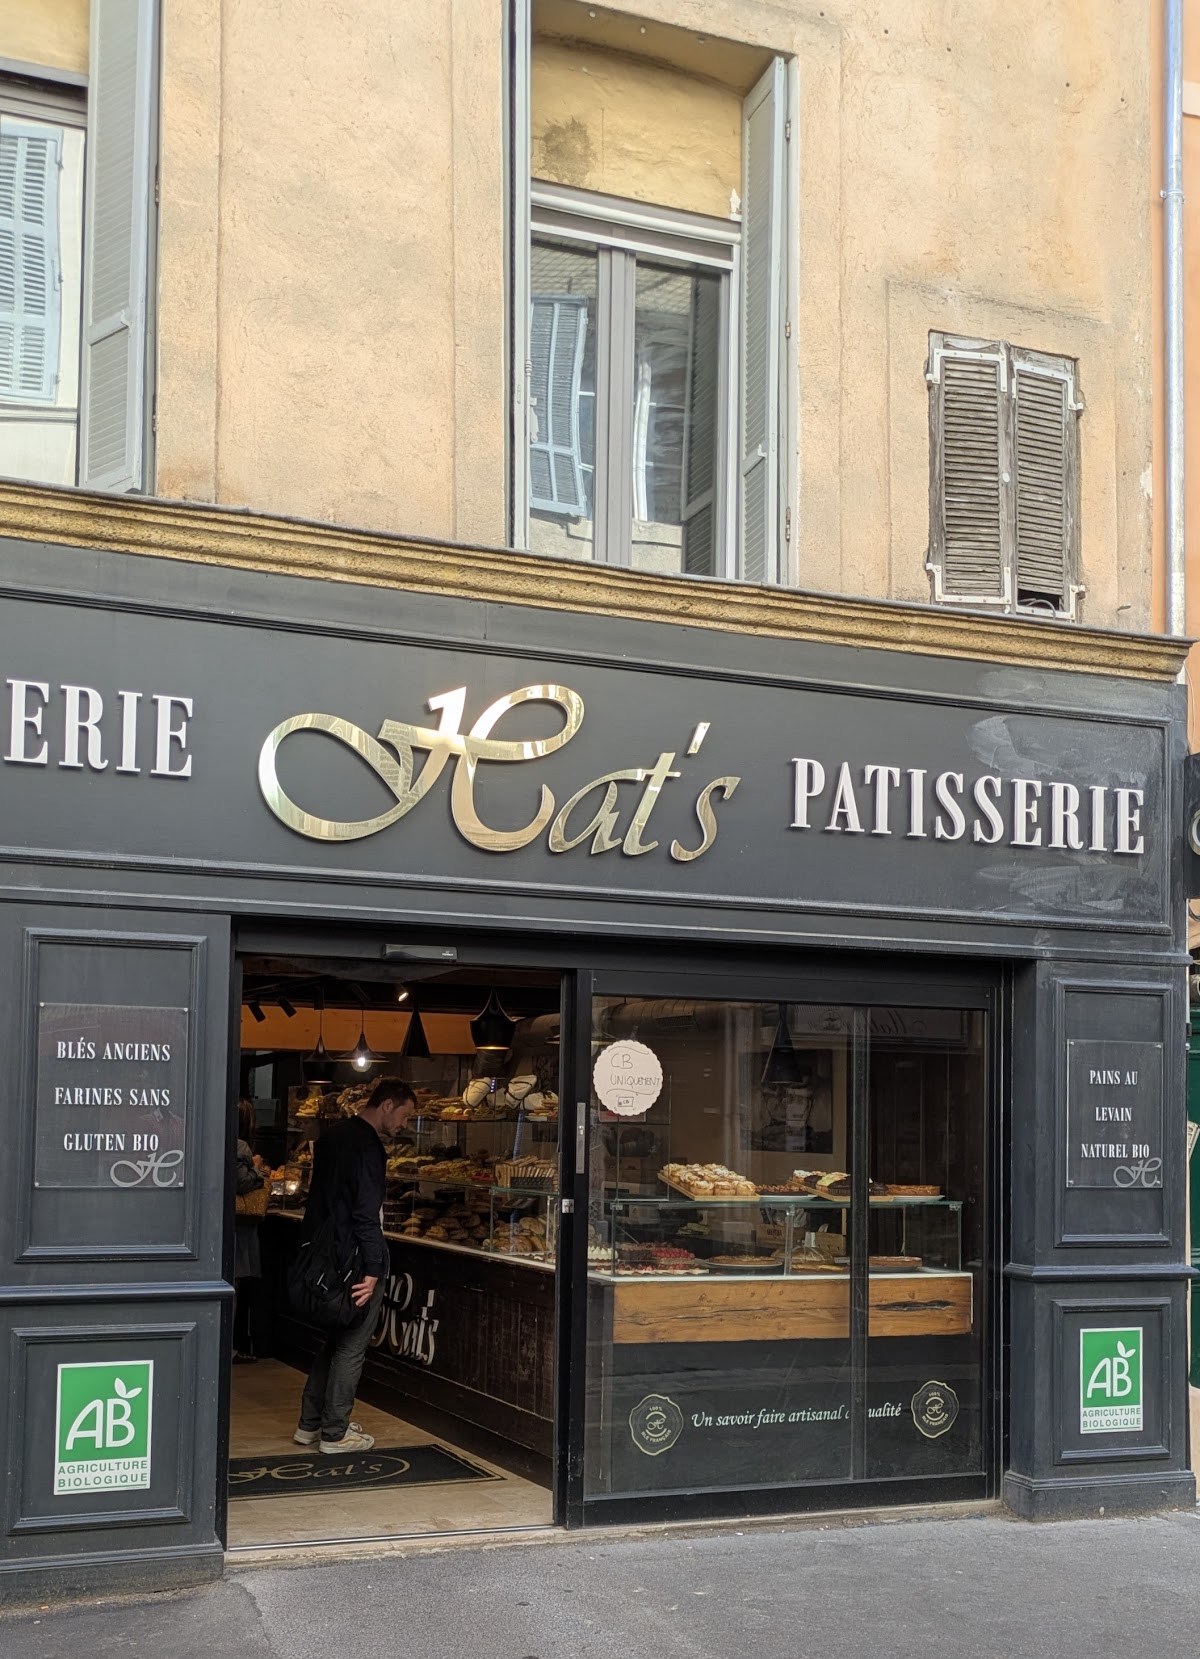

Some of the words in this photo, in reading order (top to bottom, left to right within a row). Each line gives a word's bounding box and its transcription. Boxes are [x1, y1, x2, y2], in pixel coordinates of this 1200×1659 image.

[3, 678, 194, 778] ERIE
[258, 684, 742, 862] Hat's
[789, 757, 1145, 855] PATISSERIE
[56, 1037, 96, 1060] BLÉS
[102, 1042, 171, 1062] ANCIENS
[611, 1053, 633, 1070] CB
[609, 1074, 661, 1090] UNIQUEMENT
[1089, 1070, 1121, 1085] PAINS
[1124, 1071, 1138, 1086] AU
[54, 1087, 123, 1106] FARINES
[129, 1089, 170, 1106] SANS
[1095, 1107, 1132, 1122] LEVAIN
[63, 1133, 126, 1151] GLUTEN
[132, 1134, 159, 1151] BIO
[1081, 1143, 1128, 1158] NATUREL
[1131, 1144, 1150, 1158] BIO
[1086, 1357, 1132, 1399] AB
[691, 1411, 713, 1428] Un
[715, 1410, 755, 1427] savoir
[753, 1408, 786, 1429] faire
[788, 1404, 846, 1423] artisanal
[867, 1401, 902, 1418] ualité
[1082, 1407, 1141, 1418] AGRICULTURE
[65, 1398, 136, 1450] AB
[1082, 1417, 1141, 1429] BIOLOGIQUE
[58, 1460, 148, 1475] AGRICULTURE
[58, 1472, 148, 1488] BIOLOGIQUE
